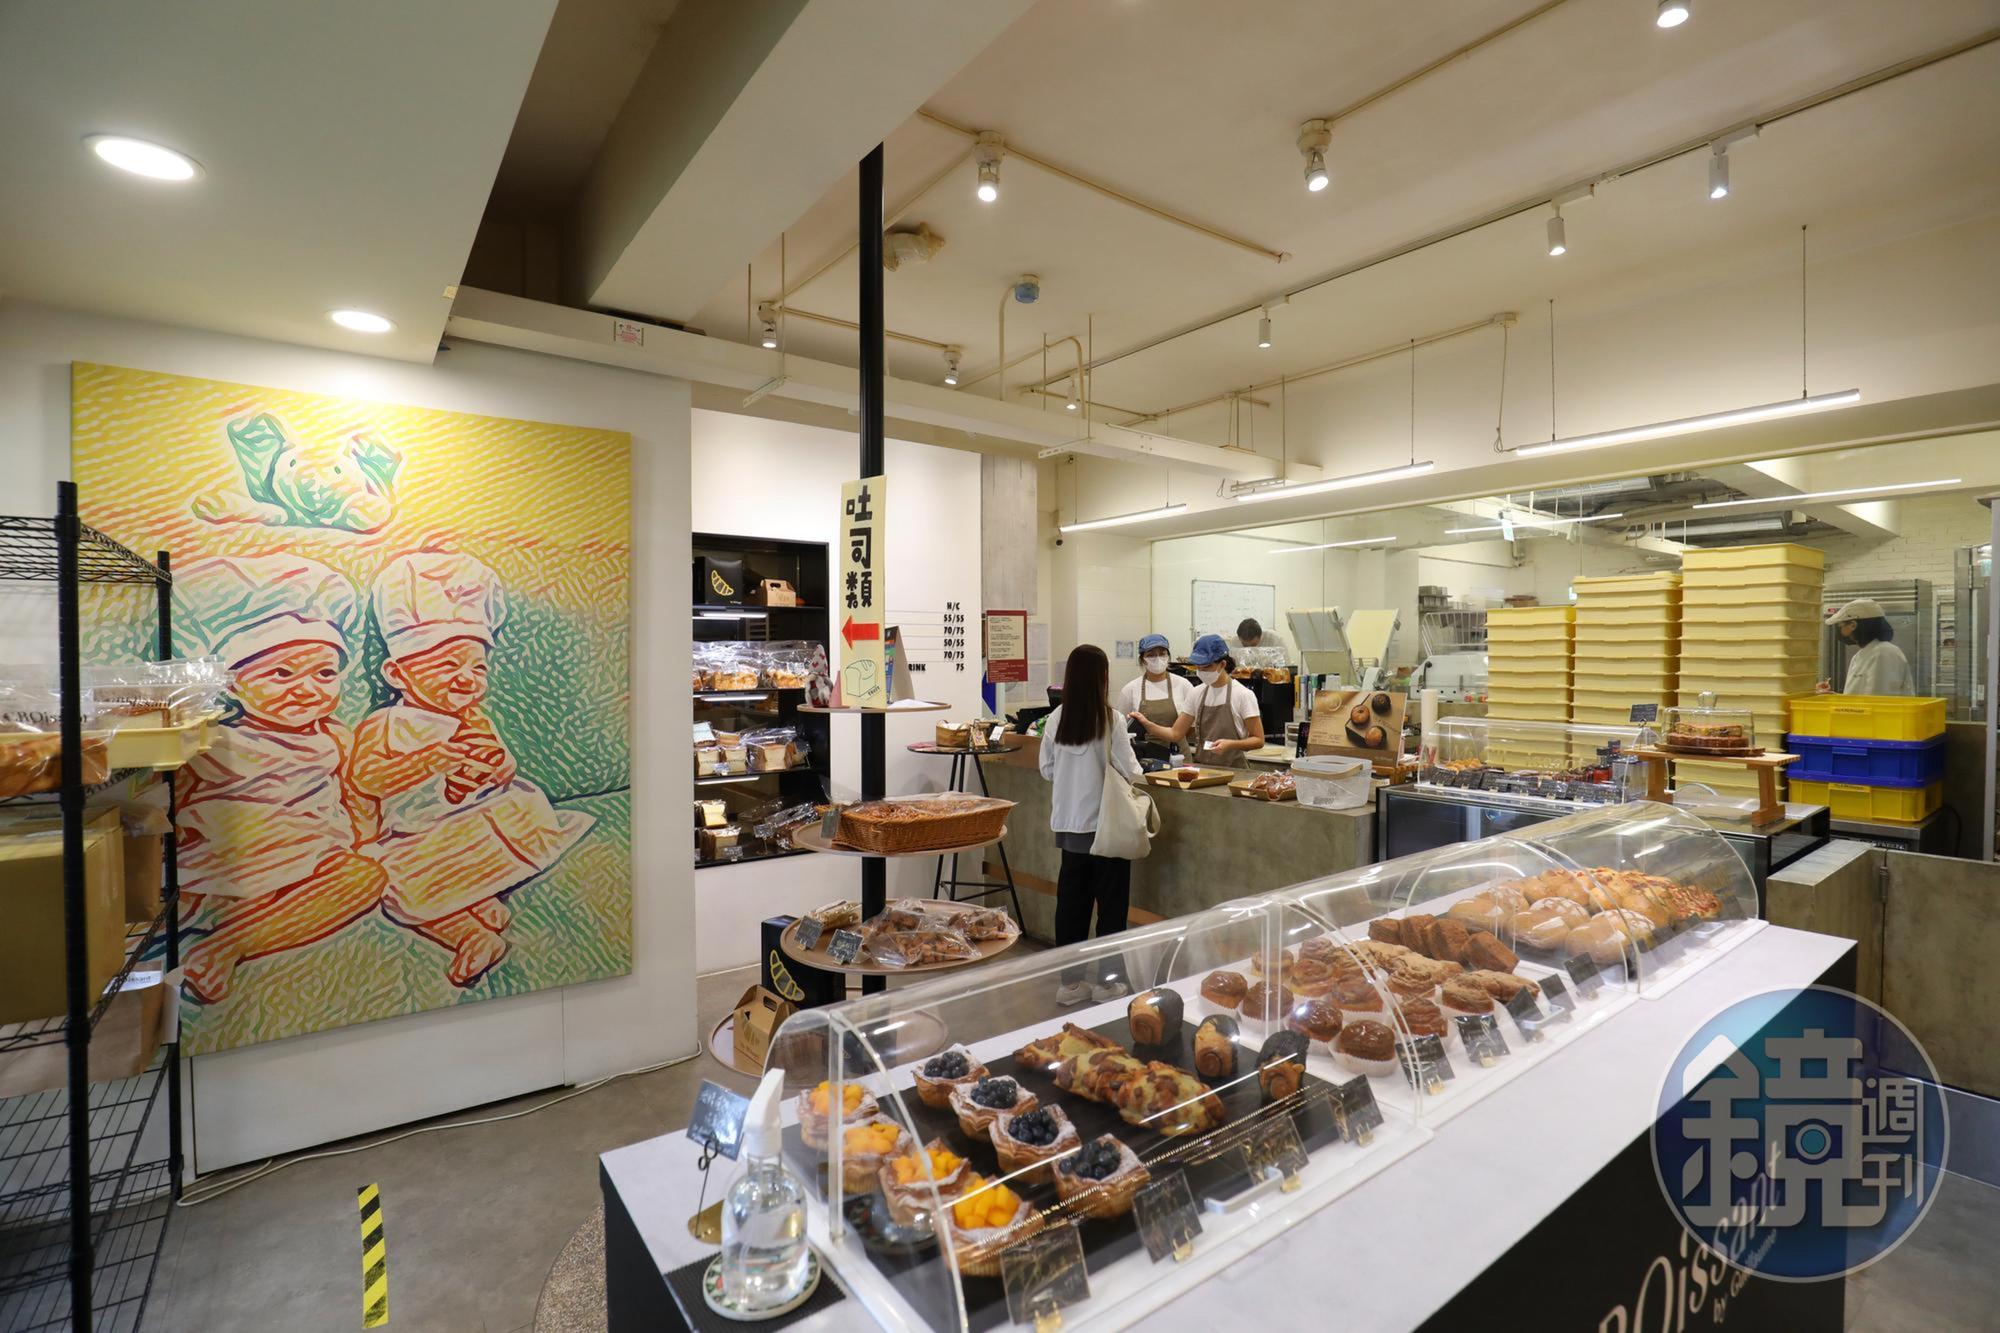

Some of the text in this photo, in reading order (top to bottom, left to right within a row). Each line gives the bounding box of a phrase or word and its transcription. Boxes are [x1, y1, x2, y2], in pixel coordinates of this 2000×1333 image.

[845, 484, 873, 609] 吐司類
[943, 626, 965, 635] 70/75
[943, 639, 965, 648] 50/55
[943, 651, 965, 660] 70/75
[955, 663, 965, 671] 75
